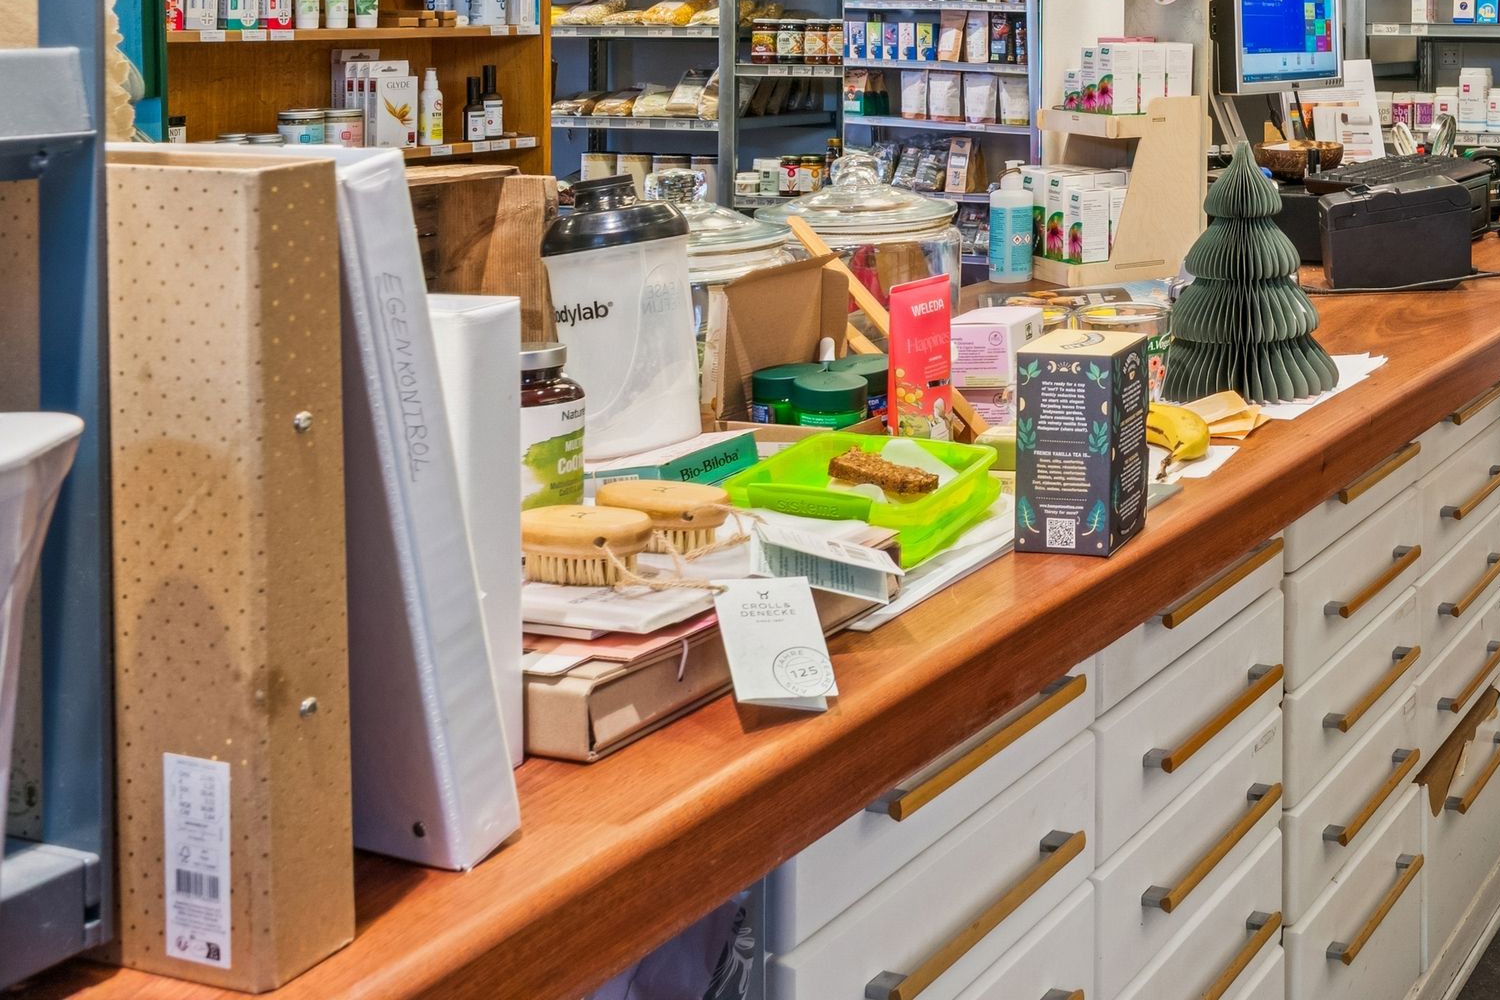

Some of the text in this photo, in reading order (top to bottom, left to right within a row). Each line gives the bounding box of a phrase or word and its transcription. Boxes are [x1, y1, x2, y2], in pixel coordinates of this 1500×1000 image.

[386, 80, 411, 90] GLYDE
[911, 298, 945, 317] WELEDA
[379, 271, 432, 475] EGENKONTROL
[680, 450, 740, 483] Bio-Biloba
[776, 499, 841, 518] sistema
[740, 608, 797, 618] DENECKE
[741, 602, 781, 610] CROLL
[789, 665, 819, 679] 125
